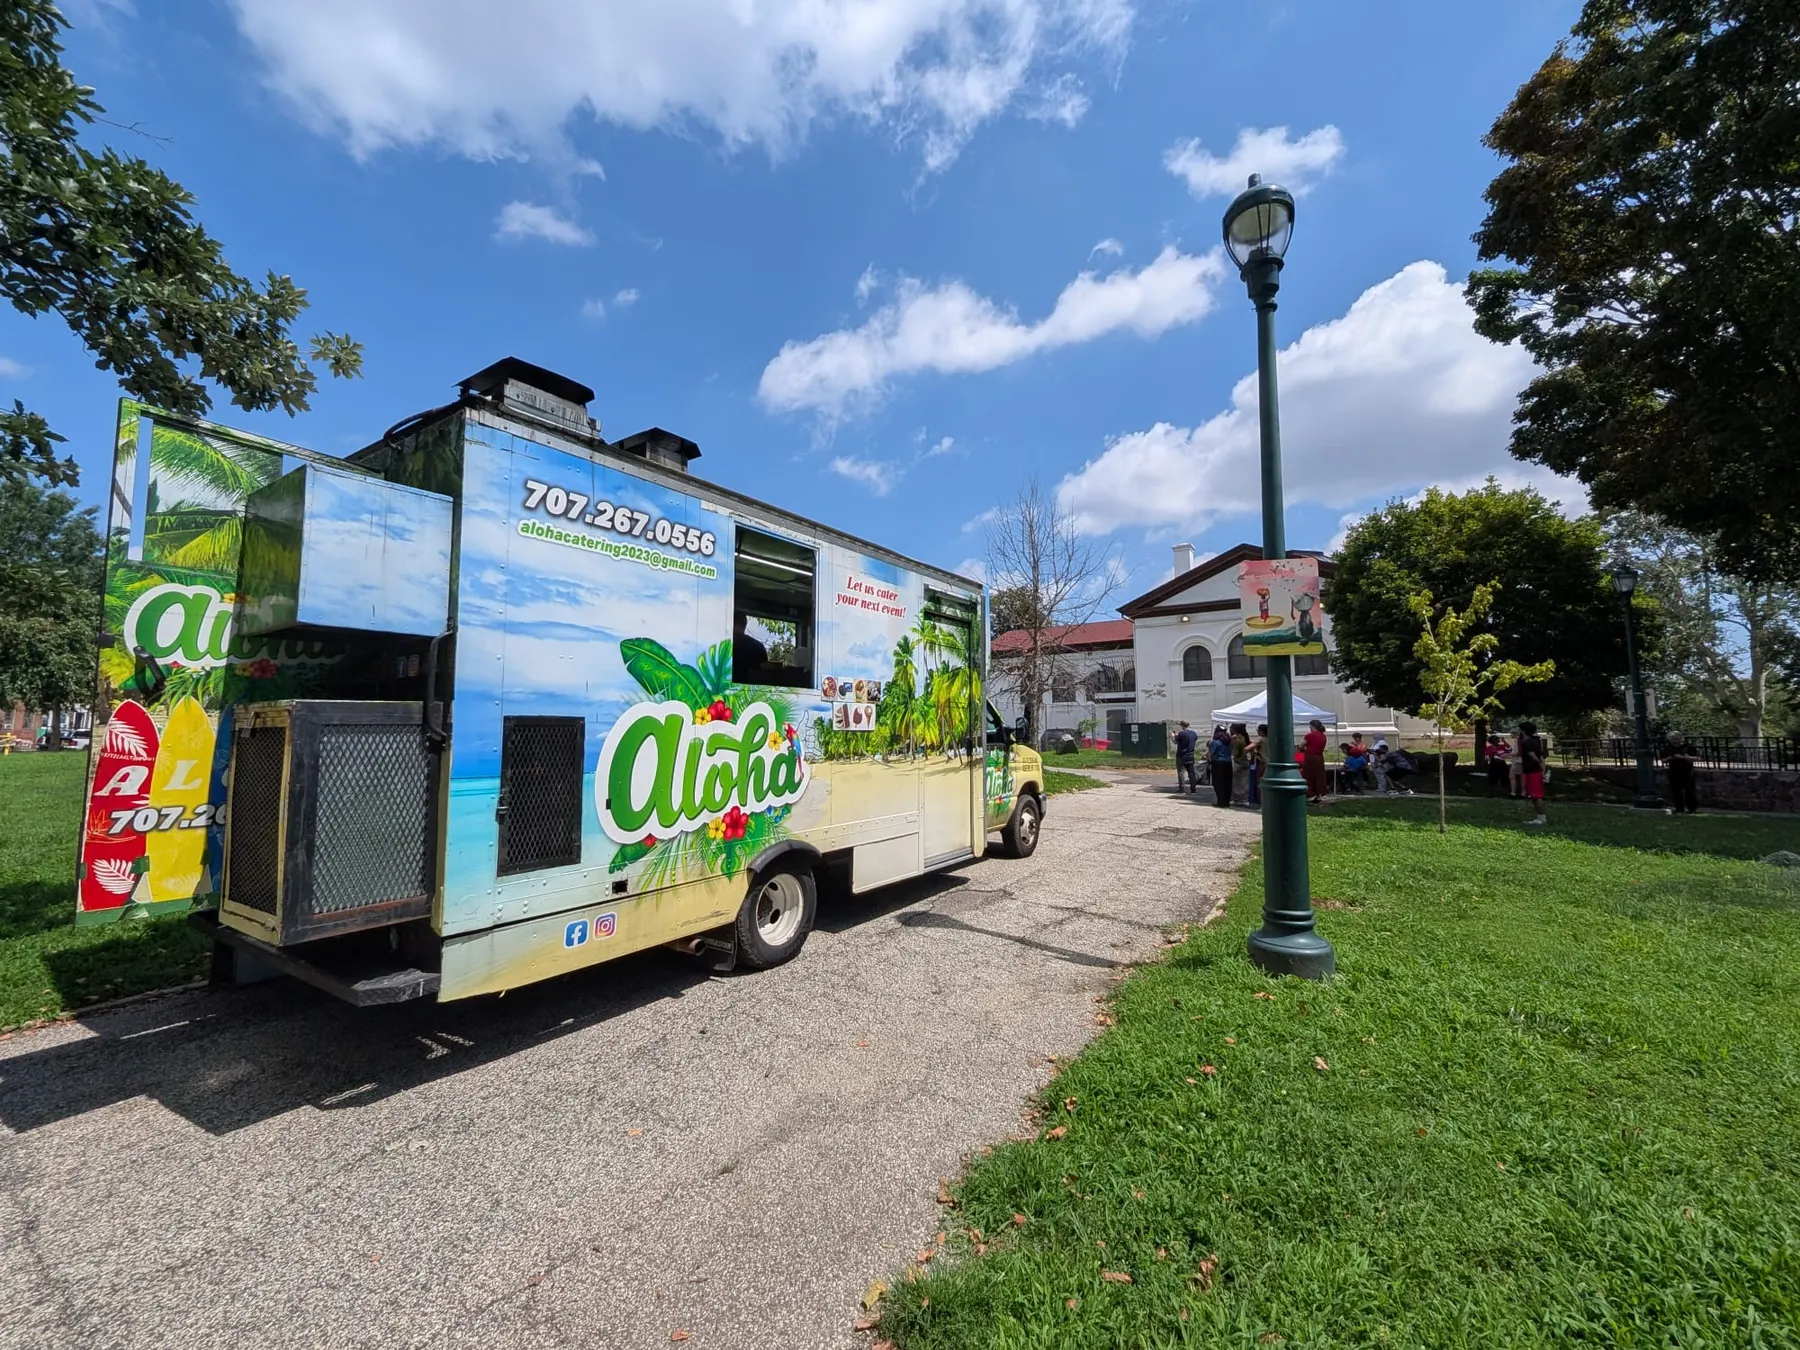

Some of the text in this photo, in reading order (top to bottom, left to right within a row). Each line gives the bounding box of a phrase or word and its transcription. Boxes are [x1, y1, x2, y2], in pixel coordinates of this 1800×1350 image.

[524, 480, 716, 556] 707.267.0556
[520, 521, 716, 578] alohacatering2023@gmail.com
[835, 592, 907, 618] your next event!
[847, 576, 899, 602] Let us cater
